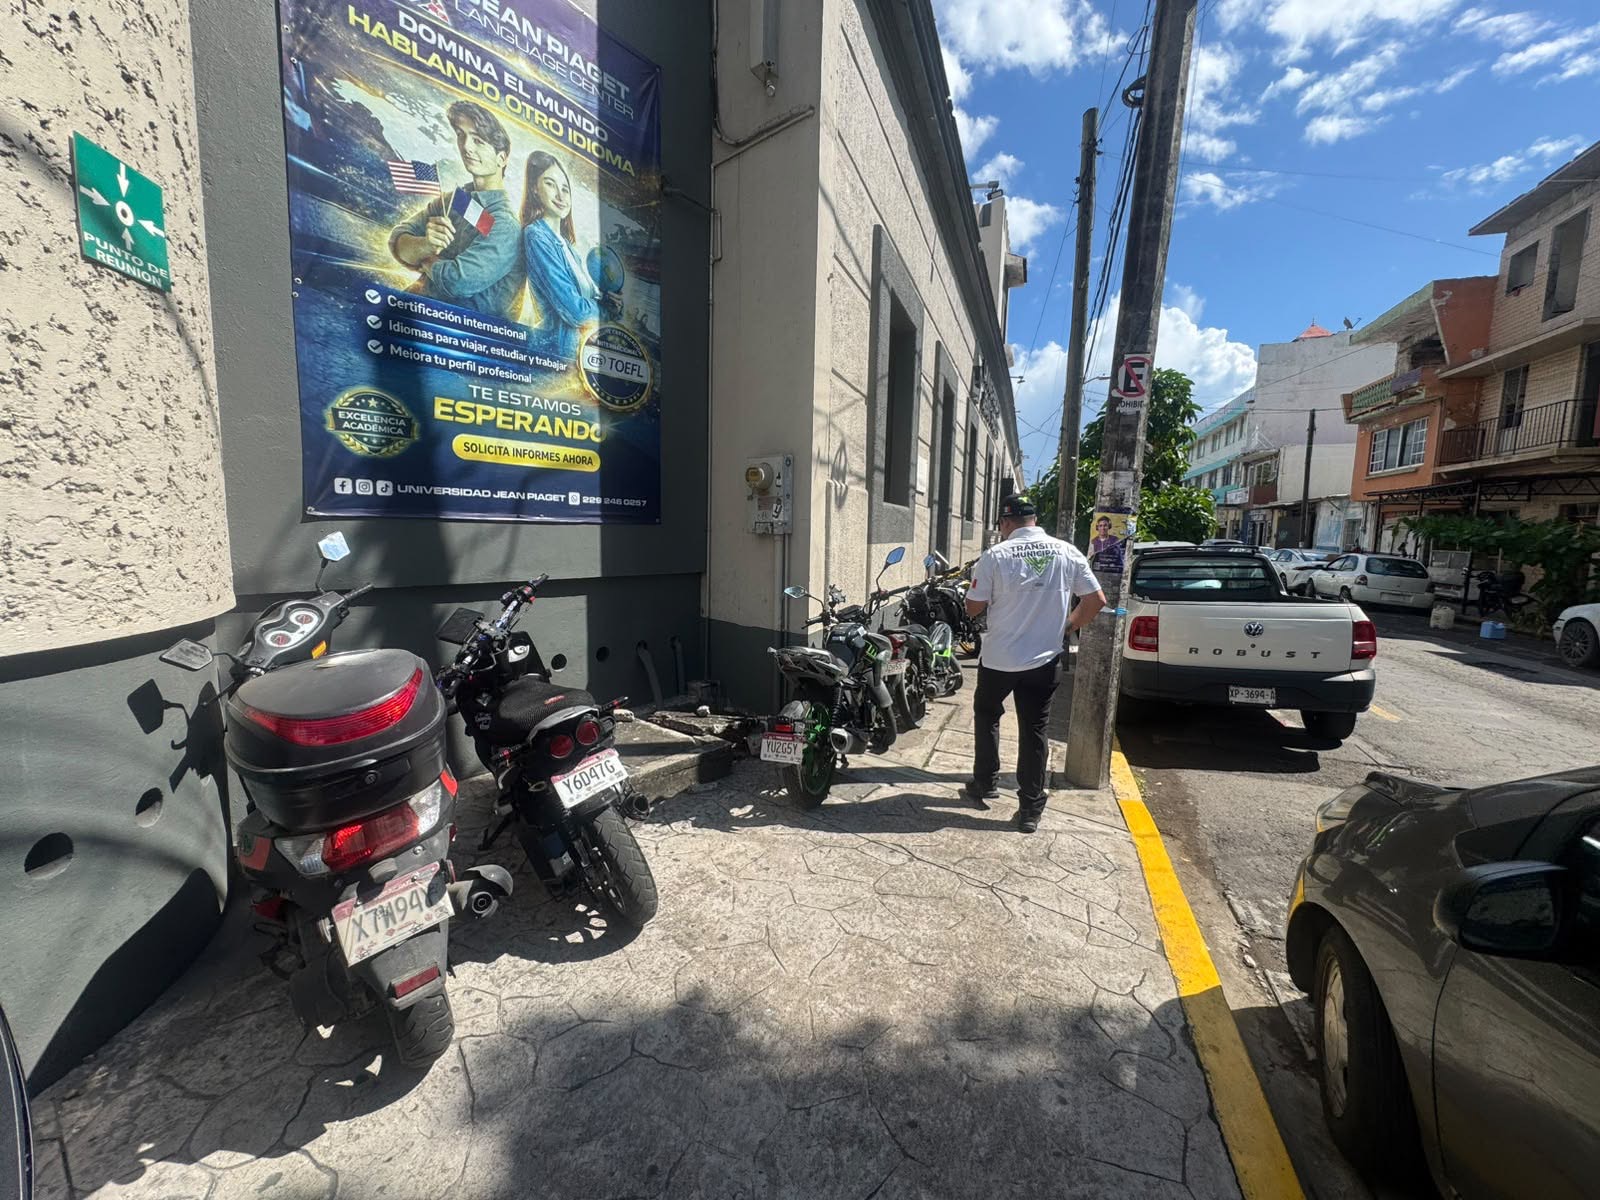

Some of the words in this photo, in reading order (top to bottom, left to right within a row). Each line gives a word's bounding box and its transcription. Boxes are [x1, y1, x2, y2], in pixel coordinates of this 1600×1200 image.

[399, 10, 499, 81] DOMINA
[504, 71, 531, 99] EL
[536, 90, 608, 142] MUNDO
[455, 0, 567, 78] LANGUAGE
[570, 70, 634, 120] CENTER
[547, 33, 630, 100] PIAGET
[348, 4, 500, 103] HABLANDO
[505, 94, 564, 137] OTRO
[568, 127, 635, 177] IDIOMA
[83, 231, 144, 268] PUNTO
[147, 262, 169, 278] DE
[95, 249, 162, 288] REUNION
[387, 294, 461, 324] Certificación
[463, 314, 527, 341] internacional
[389, 319, 434, 340] Idiomas
[435, 332, 459, 346] para
[460, 338, 489, 354] viajar,
[490, 346, 527, 362] estudiar
[528, 355, 535, 366] y
[535, 355, 567, 372] trabajar
[390, 343, 432, 363] Mejora
[434, 354, 446, 366] tu
[448, 359, 476, 373] perfil
[478, 365, 532, 384] profesional
[591, 356, 603, 367] ETS
[608, 357, 644, 378] TOEFL
[338, 410, 406, 427] EXCELENCIA
[433, 397, 607, 443] ESPERANDO
[468, 384, 493, 401] TE
[498, 390, 582, 416] ESTAMOS
[463, 441, 510, 457] SOLICITA
[512, 448, 561, 463] INFORMES
[562, 454, 594, 466] AHORA
[397, 484, 491, 498] UNIVERSIDAD
[493, 490, 526, 500] JEAN
[527, 493, 566, 502] PIAGET
[582, 496, 602, 504] 229
[1012, 550, 1062, 559] MUNICIPAL
[1188, 647, 1321, 659] ROBUST
[352, 886, 430, 942] X7W94
